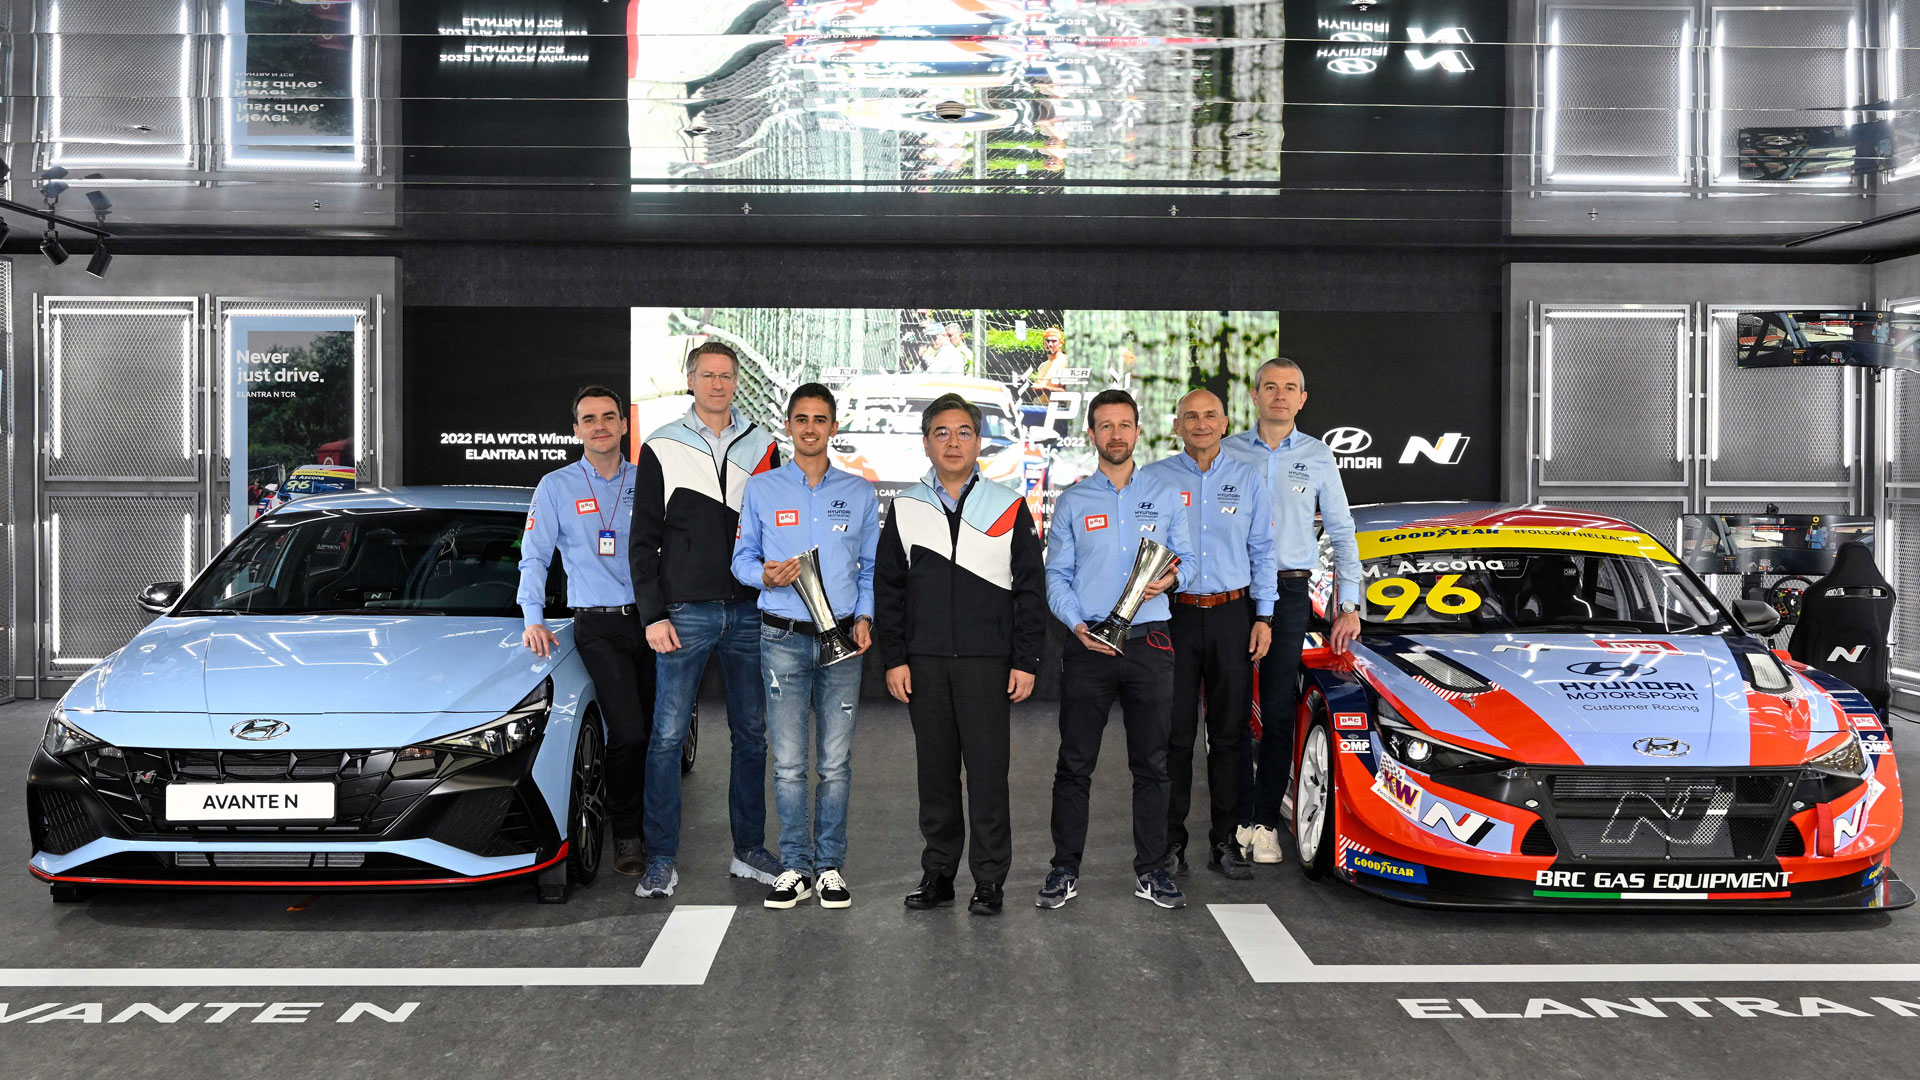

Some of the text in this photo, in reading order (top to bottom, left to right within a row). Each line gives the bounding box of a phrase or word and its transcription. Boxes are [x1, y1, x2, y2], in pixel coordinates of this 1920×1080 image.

[236, 349, 289, 364] Never
[237, 367, 325, 384] just drive.
[440, 432, 584, 445] 2022 FIA WTCR Winner
[1056, 436, 1086, 447] 2022
[465, 448, 567, 460] ELANTRA N TCR
[287, 480, 311, 490] 96
[1360, 560, 1505, 578] M. Azcona
[1366, 574, 1482, 622] 96
[1558, 681, 1695, 692] HYUNDAI
[1566, 691, 1699, 701] MOTORSPORT
[1582, 703, 1700, 712] Customer Racing
[1339, 741, 1370, 751] OMP
[203, 794, 298, 809] AVANTE N
[1354, 856, 1415, 878] GOODYEAR
[1536, 869, 1793, 890] BRC GAS EQUIPMENT
[0, 1002, 421, 1024] VANTE N
[1397, 997, 1876, 1018] ELANTRA
